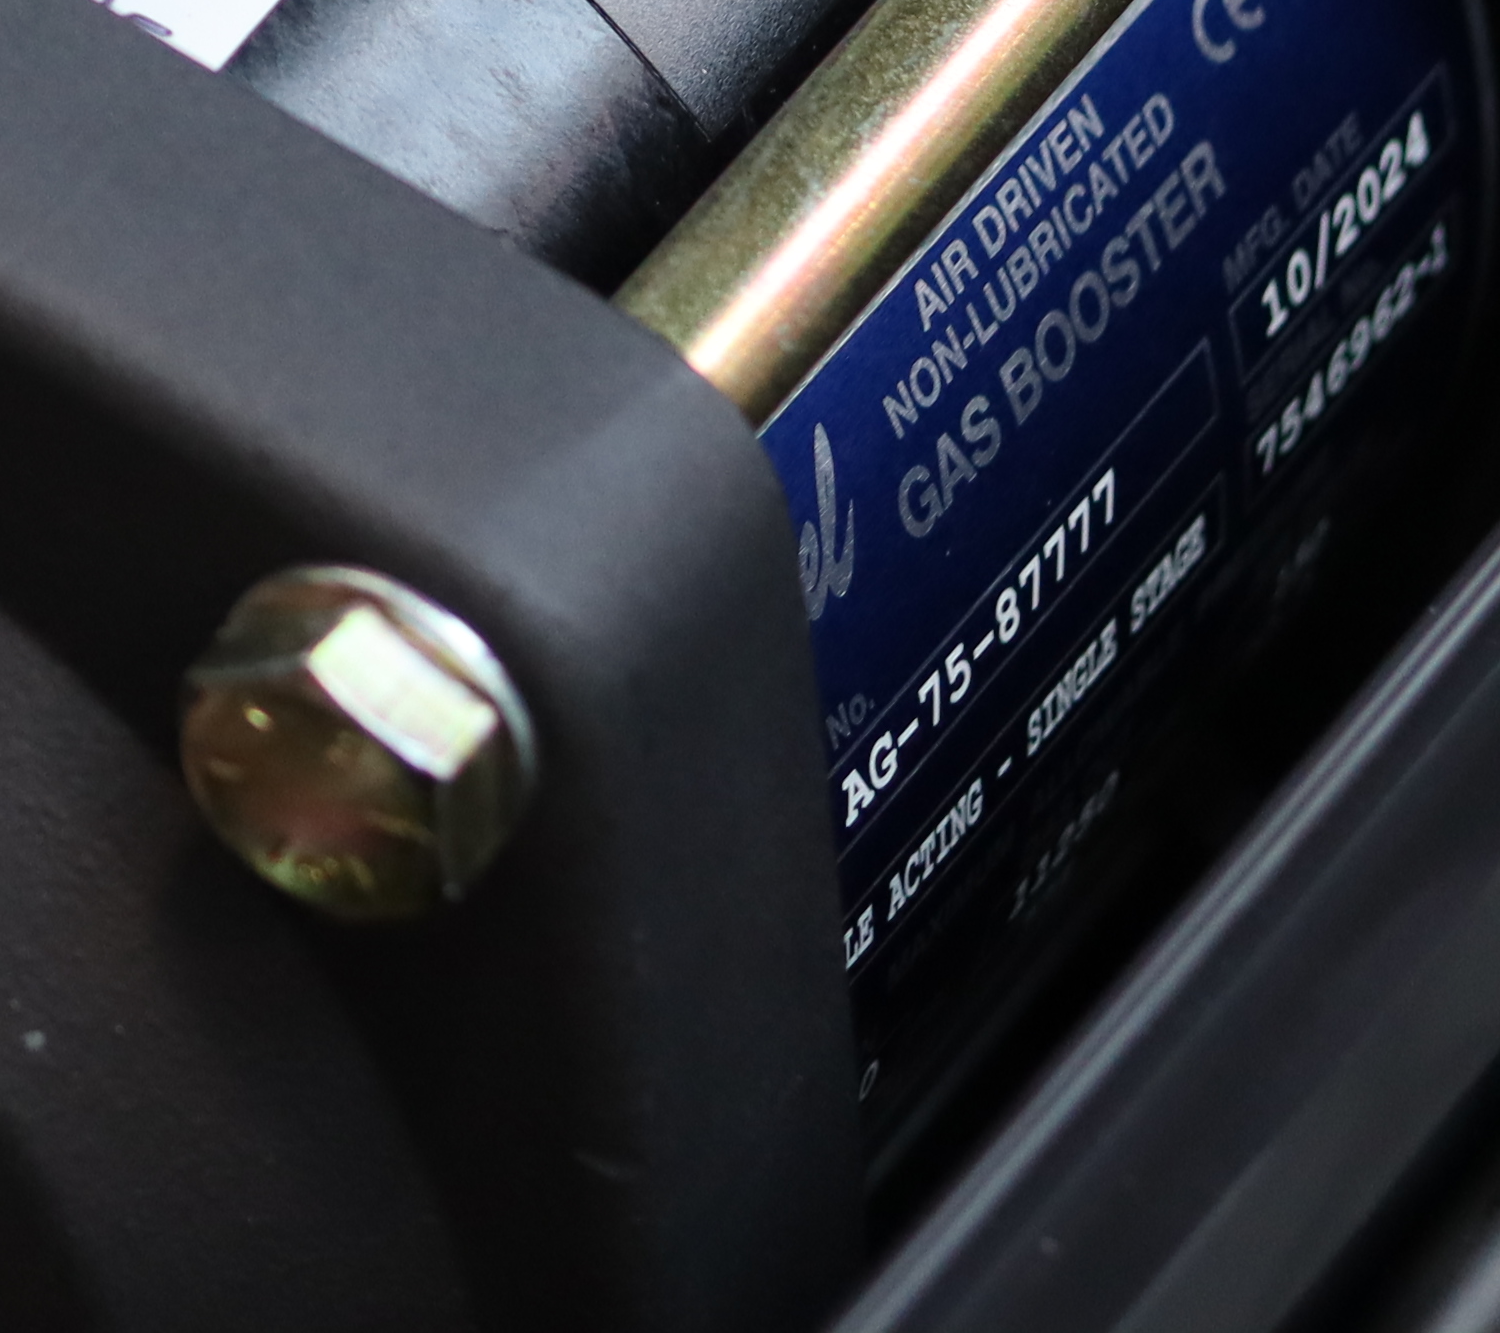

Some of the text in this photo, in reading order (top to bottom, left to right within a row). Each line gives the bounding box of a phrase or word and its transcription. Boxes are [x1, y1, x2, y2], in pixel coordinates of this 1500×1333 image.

[882, 93, 1175, 438] NON-LUBRICATED
[899, 394, 1002, 538] GAS
[1000, 141, 1228, 426] BOOSTER
[913, 93, 1105, 332] AIR DRIVEN
[1261, 111, 1430, 337] 10/2024
[842, 468, 1116, 827] AG-75-87777
[887, 778, 985, 923] ACTING
[1026, 619, 1119, 757] SINGLE
[1130, 513, 1206, 634] STAGE
